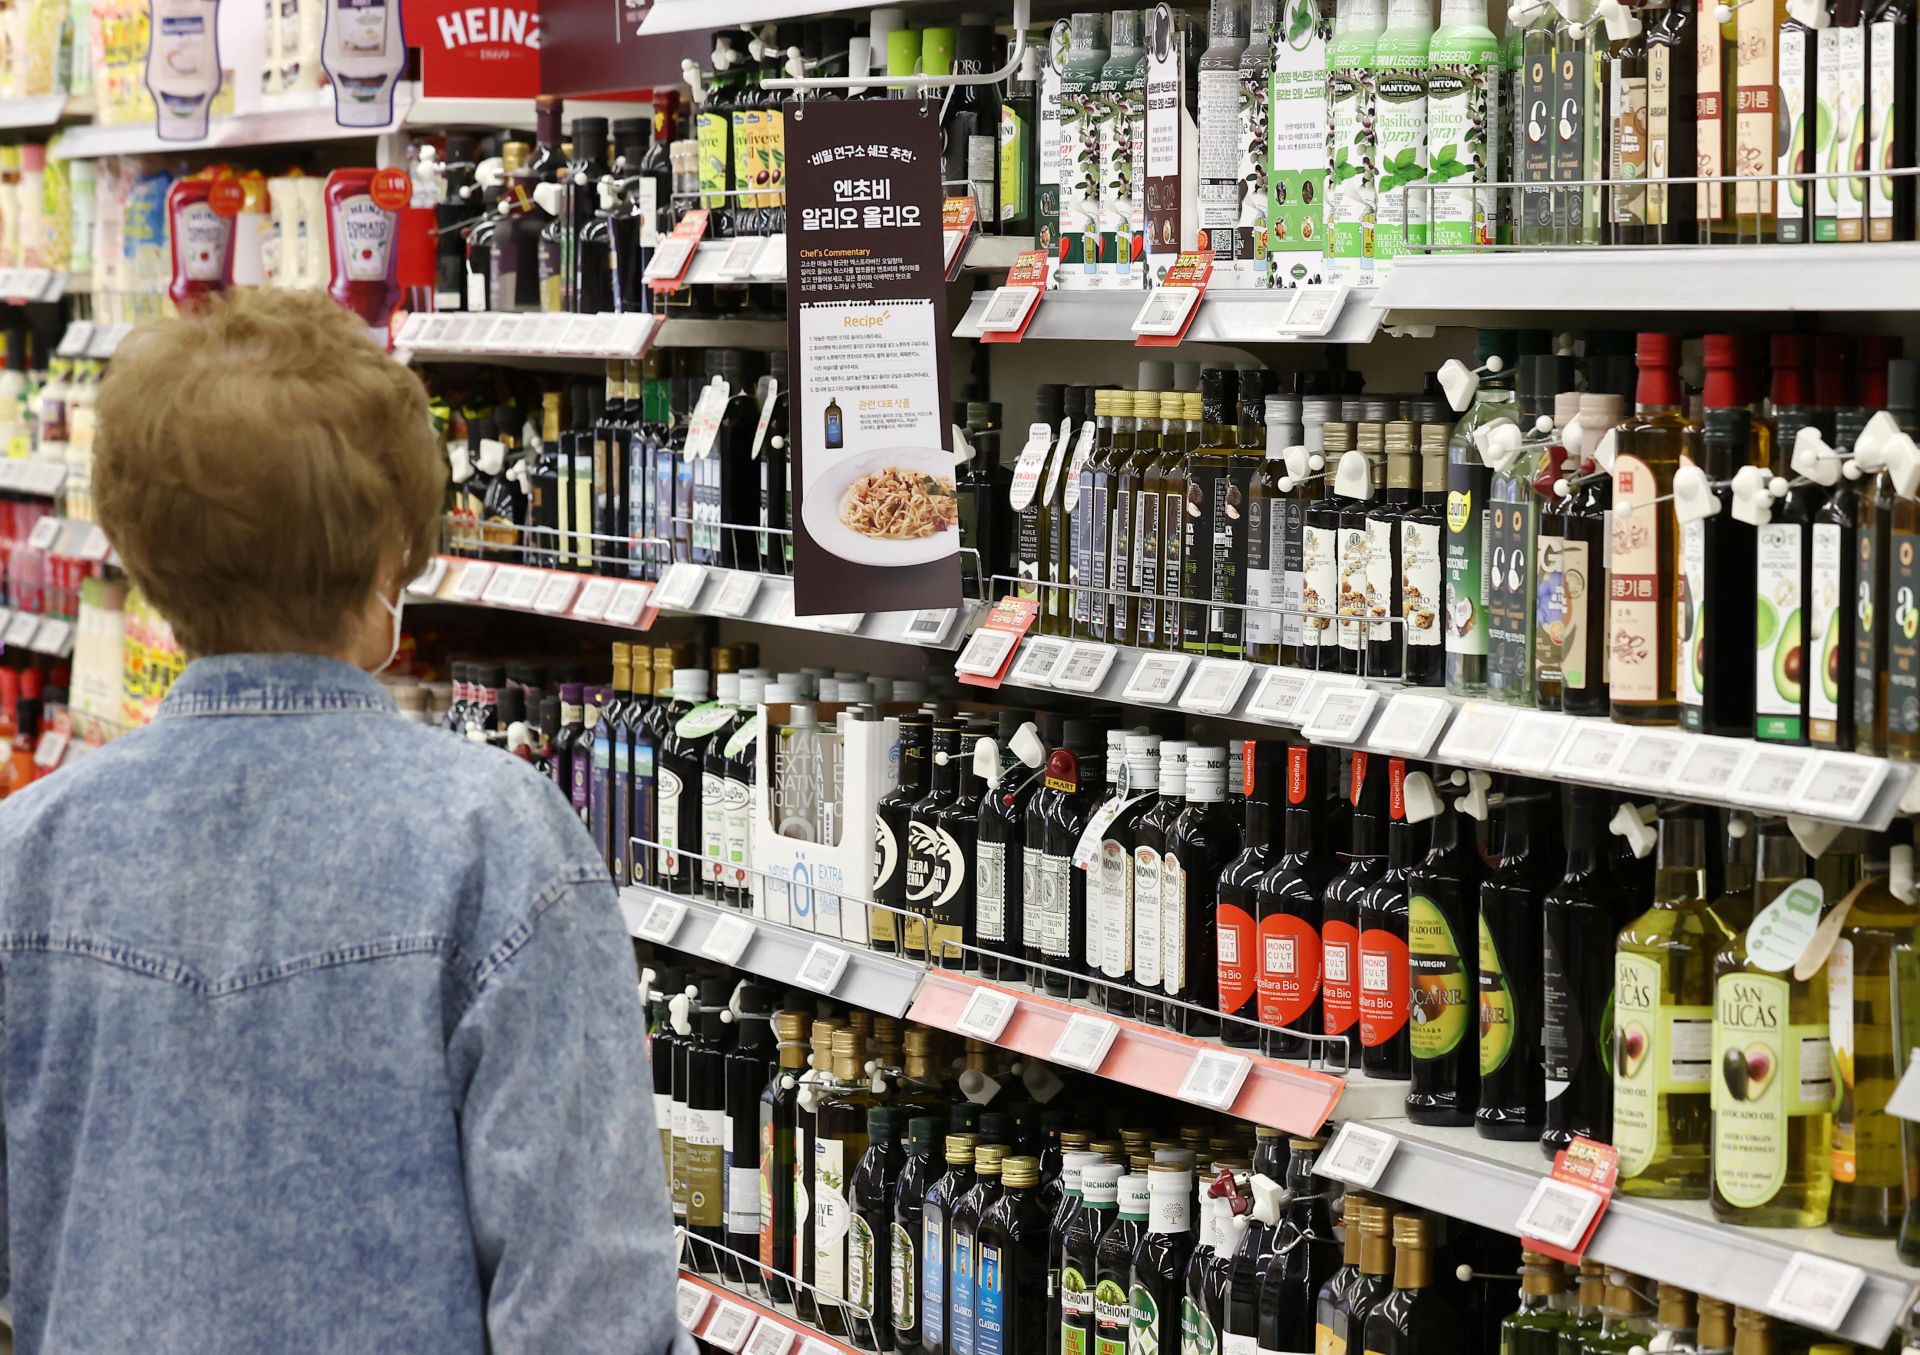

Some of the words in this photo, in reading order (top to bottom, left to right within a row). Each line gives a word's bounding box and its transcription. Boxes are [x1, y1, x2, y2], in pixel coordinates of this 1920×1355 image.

[1380, 84, 1421, 93] MANTOVA
[1380, 114, 1421, 127] Basilico
[811, 149, 833, 166] 비밀
[834, 145, 866, 160] 연구소
[867, 144, 889, 159] 쉐프
[890, 146, 912, 164] 추천
[833, 178, 891, 202] 엔초비
[802, 207, 859, 231] 알리오
[862, 205, 921, 229] 올리오
[800, 249, 823, 258] Chef's
[823, 248, 871, 258] Commentary
[843, 316, 884, 328] Recipe
[1761, 562, 1797, 570] AVOCADO
[1293, 755, 1301, 794] Nocellara
[1047, 778, 1075, 790] E-MART
[1103, 857, 1121, 872] MONINI
[1136, 864, 1157, 880] MONINI
[1429, 926, 1444, 936] OIL
[1267, 942, 1292, 951] MONO
[1267, 951, 1291, 961] CULT
[1326, 949, 1344, 959] MONO
[1268, 962, 1292, 971] IVAR
[1364, 959, 1386, 968] MONO
[1419, 960, 1447, 970] VIRGIN
[1228, 971, 1242, 981] Bio
[1619, 963, 1638, 985] SAN
[1282, 982, 1300, 992] Bio
[1336, 990, 1352, 999] Bio
[1734, 983, 1762, 1003] SAN
[1377, 998, 1394, 1009] Bio
[1722, 999, 1777, 1029] LUCAS
[953, 1303, 972, 1318] CLASSICO
[978, 1317, 1000, 1332] CLASSICO
[1101, 1343, 1115, 1354] OLIO
